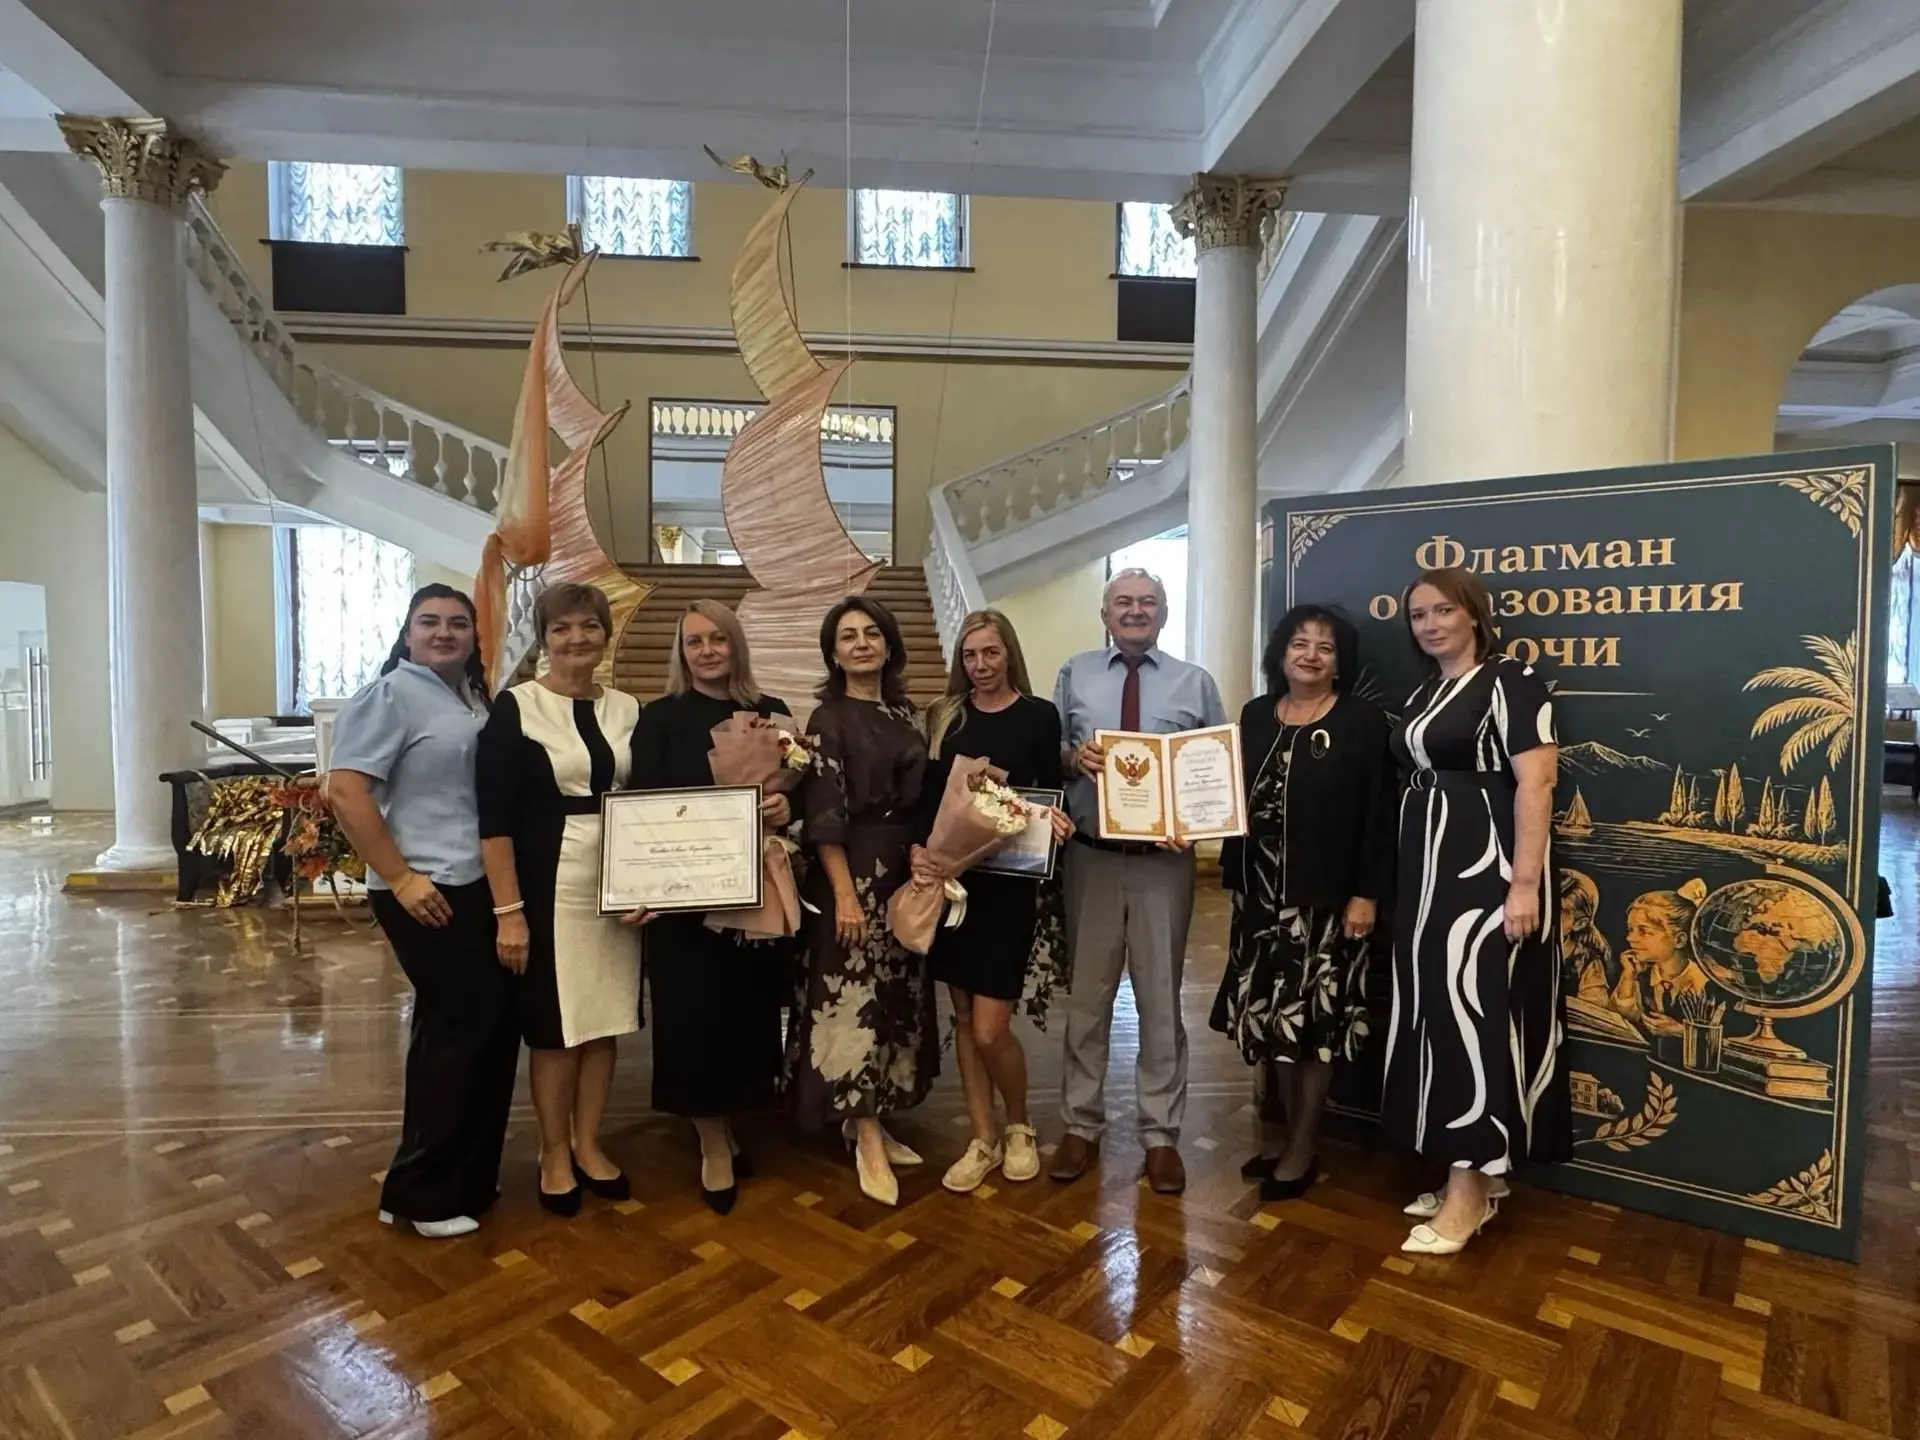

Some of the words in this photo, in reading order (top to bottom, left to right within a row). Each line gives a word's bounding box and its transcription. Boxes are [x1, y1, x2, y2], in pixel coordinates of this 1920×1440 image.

[1415, 535, 1676, 575] Флагман
[1369, 581, 1744, 621] озования
[1491, 626, 1622, 667] очи
